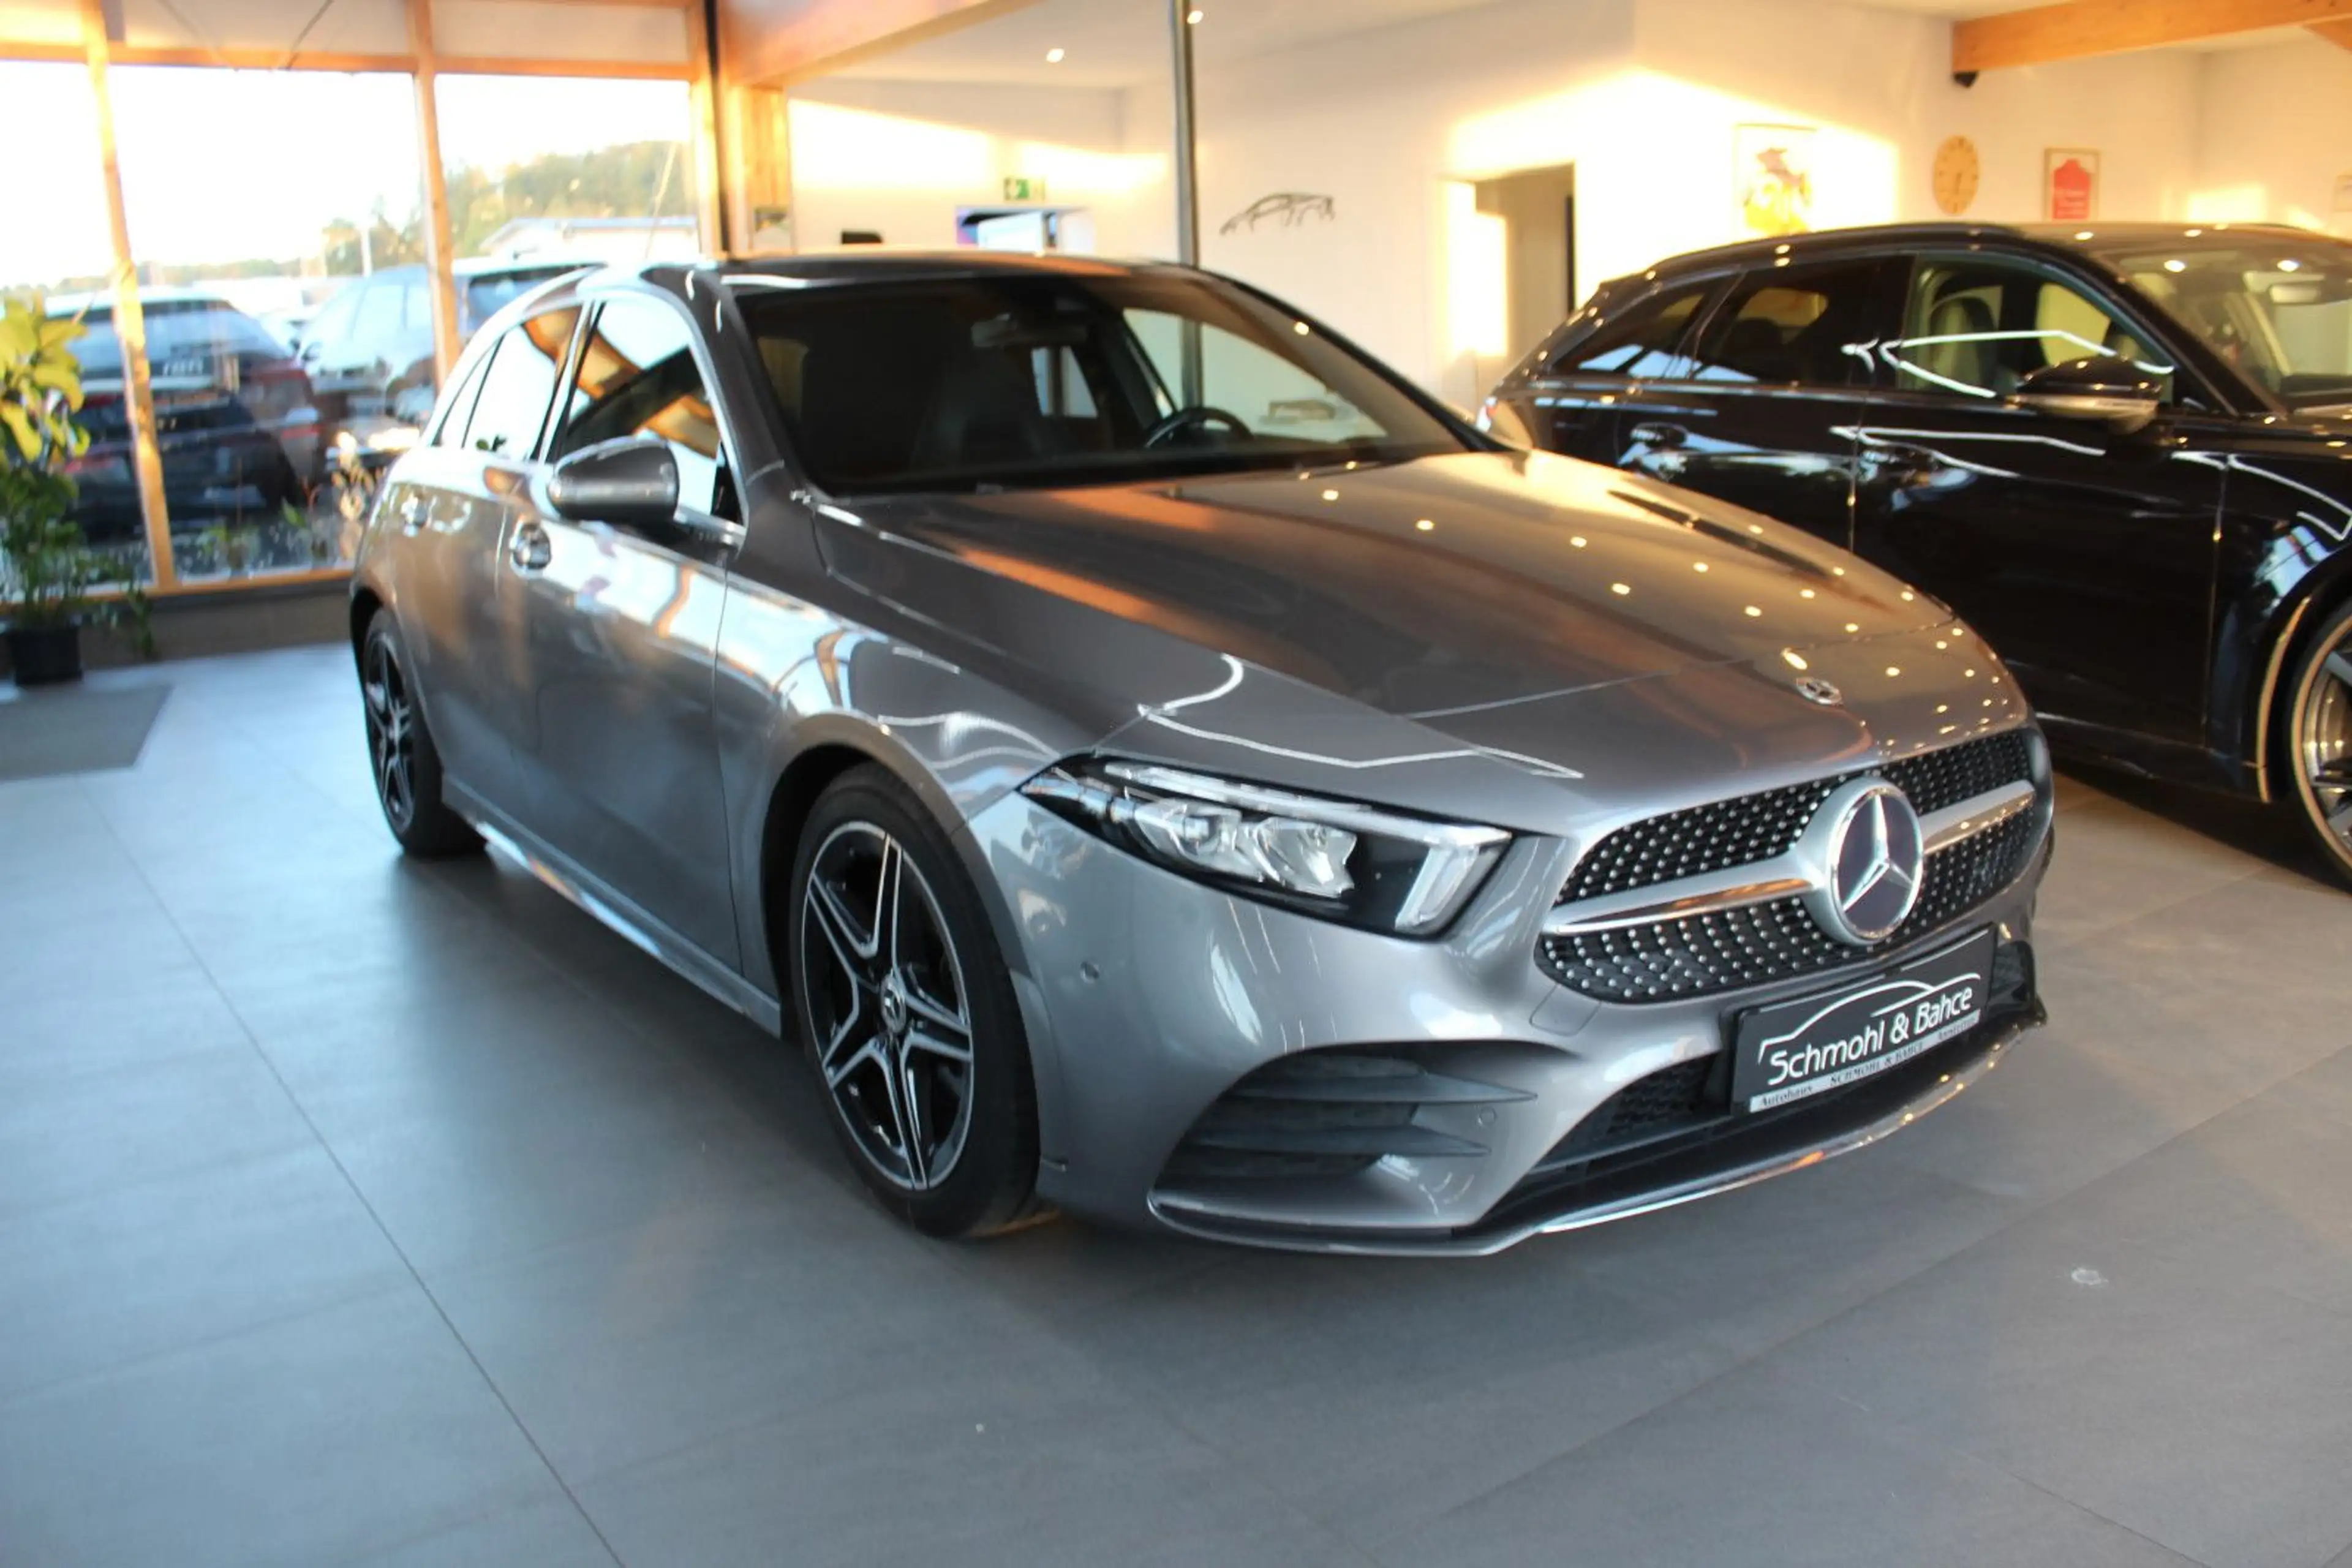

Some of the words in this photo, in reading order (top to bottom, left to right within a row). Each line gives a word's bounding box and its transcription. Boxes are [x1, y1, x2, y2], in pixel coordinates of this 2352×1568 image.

[1767, 1020, 1885, 1086] Schmohl
[1889, 1011, 1909, 1044] &
[1913, 987, 1973, 1035] Bahce
